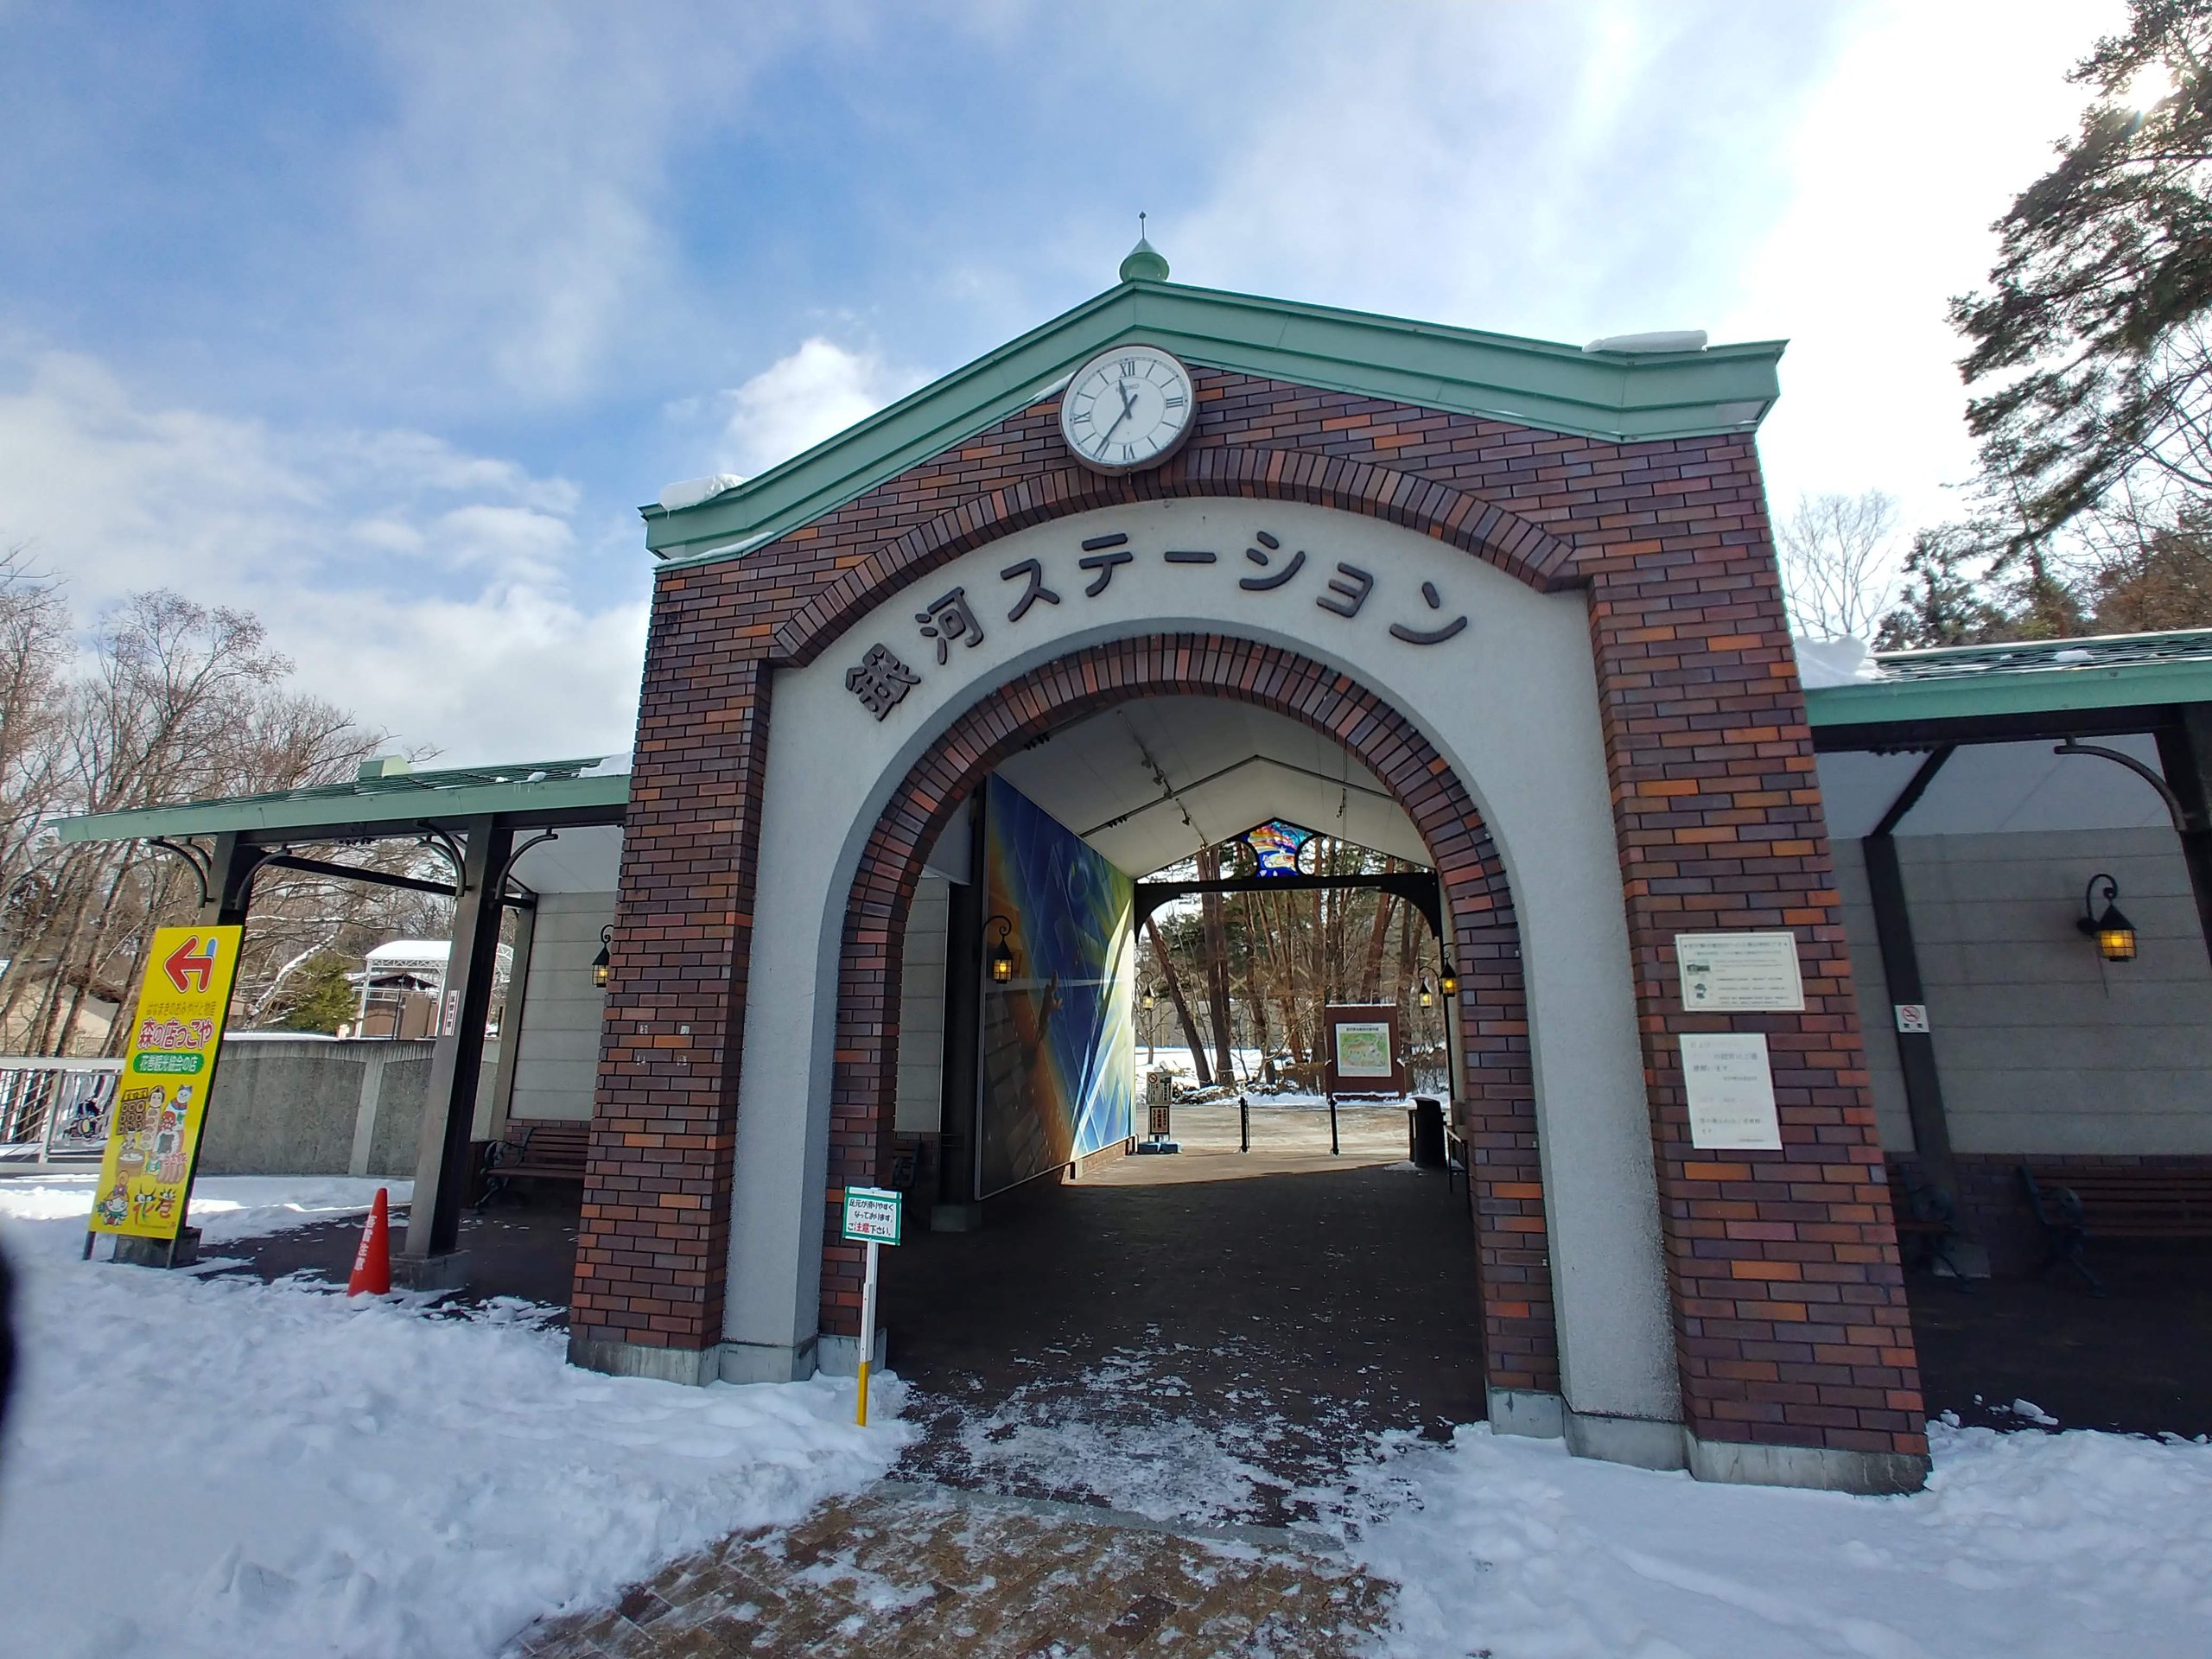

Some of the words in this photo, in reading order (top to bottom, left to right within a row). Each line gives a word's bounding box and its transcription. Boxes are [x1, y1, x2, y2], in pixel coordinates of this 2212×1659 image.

[1120, 361, 1135, 378] XII
[849, 1198, 894, 1211] 足元が滑りやすく
[847, 1221, 891, 1236] ご注意下さい。
